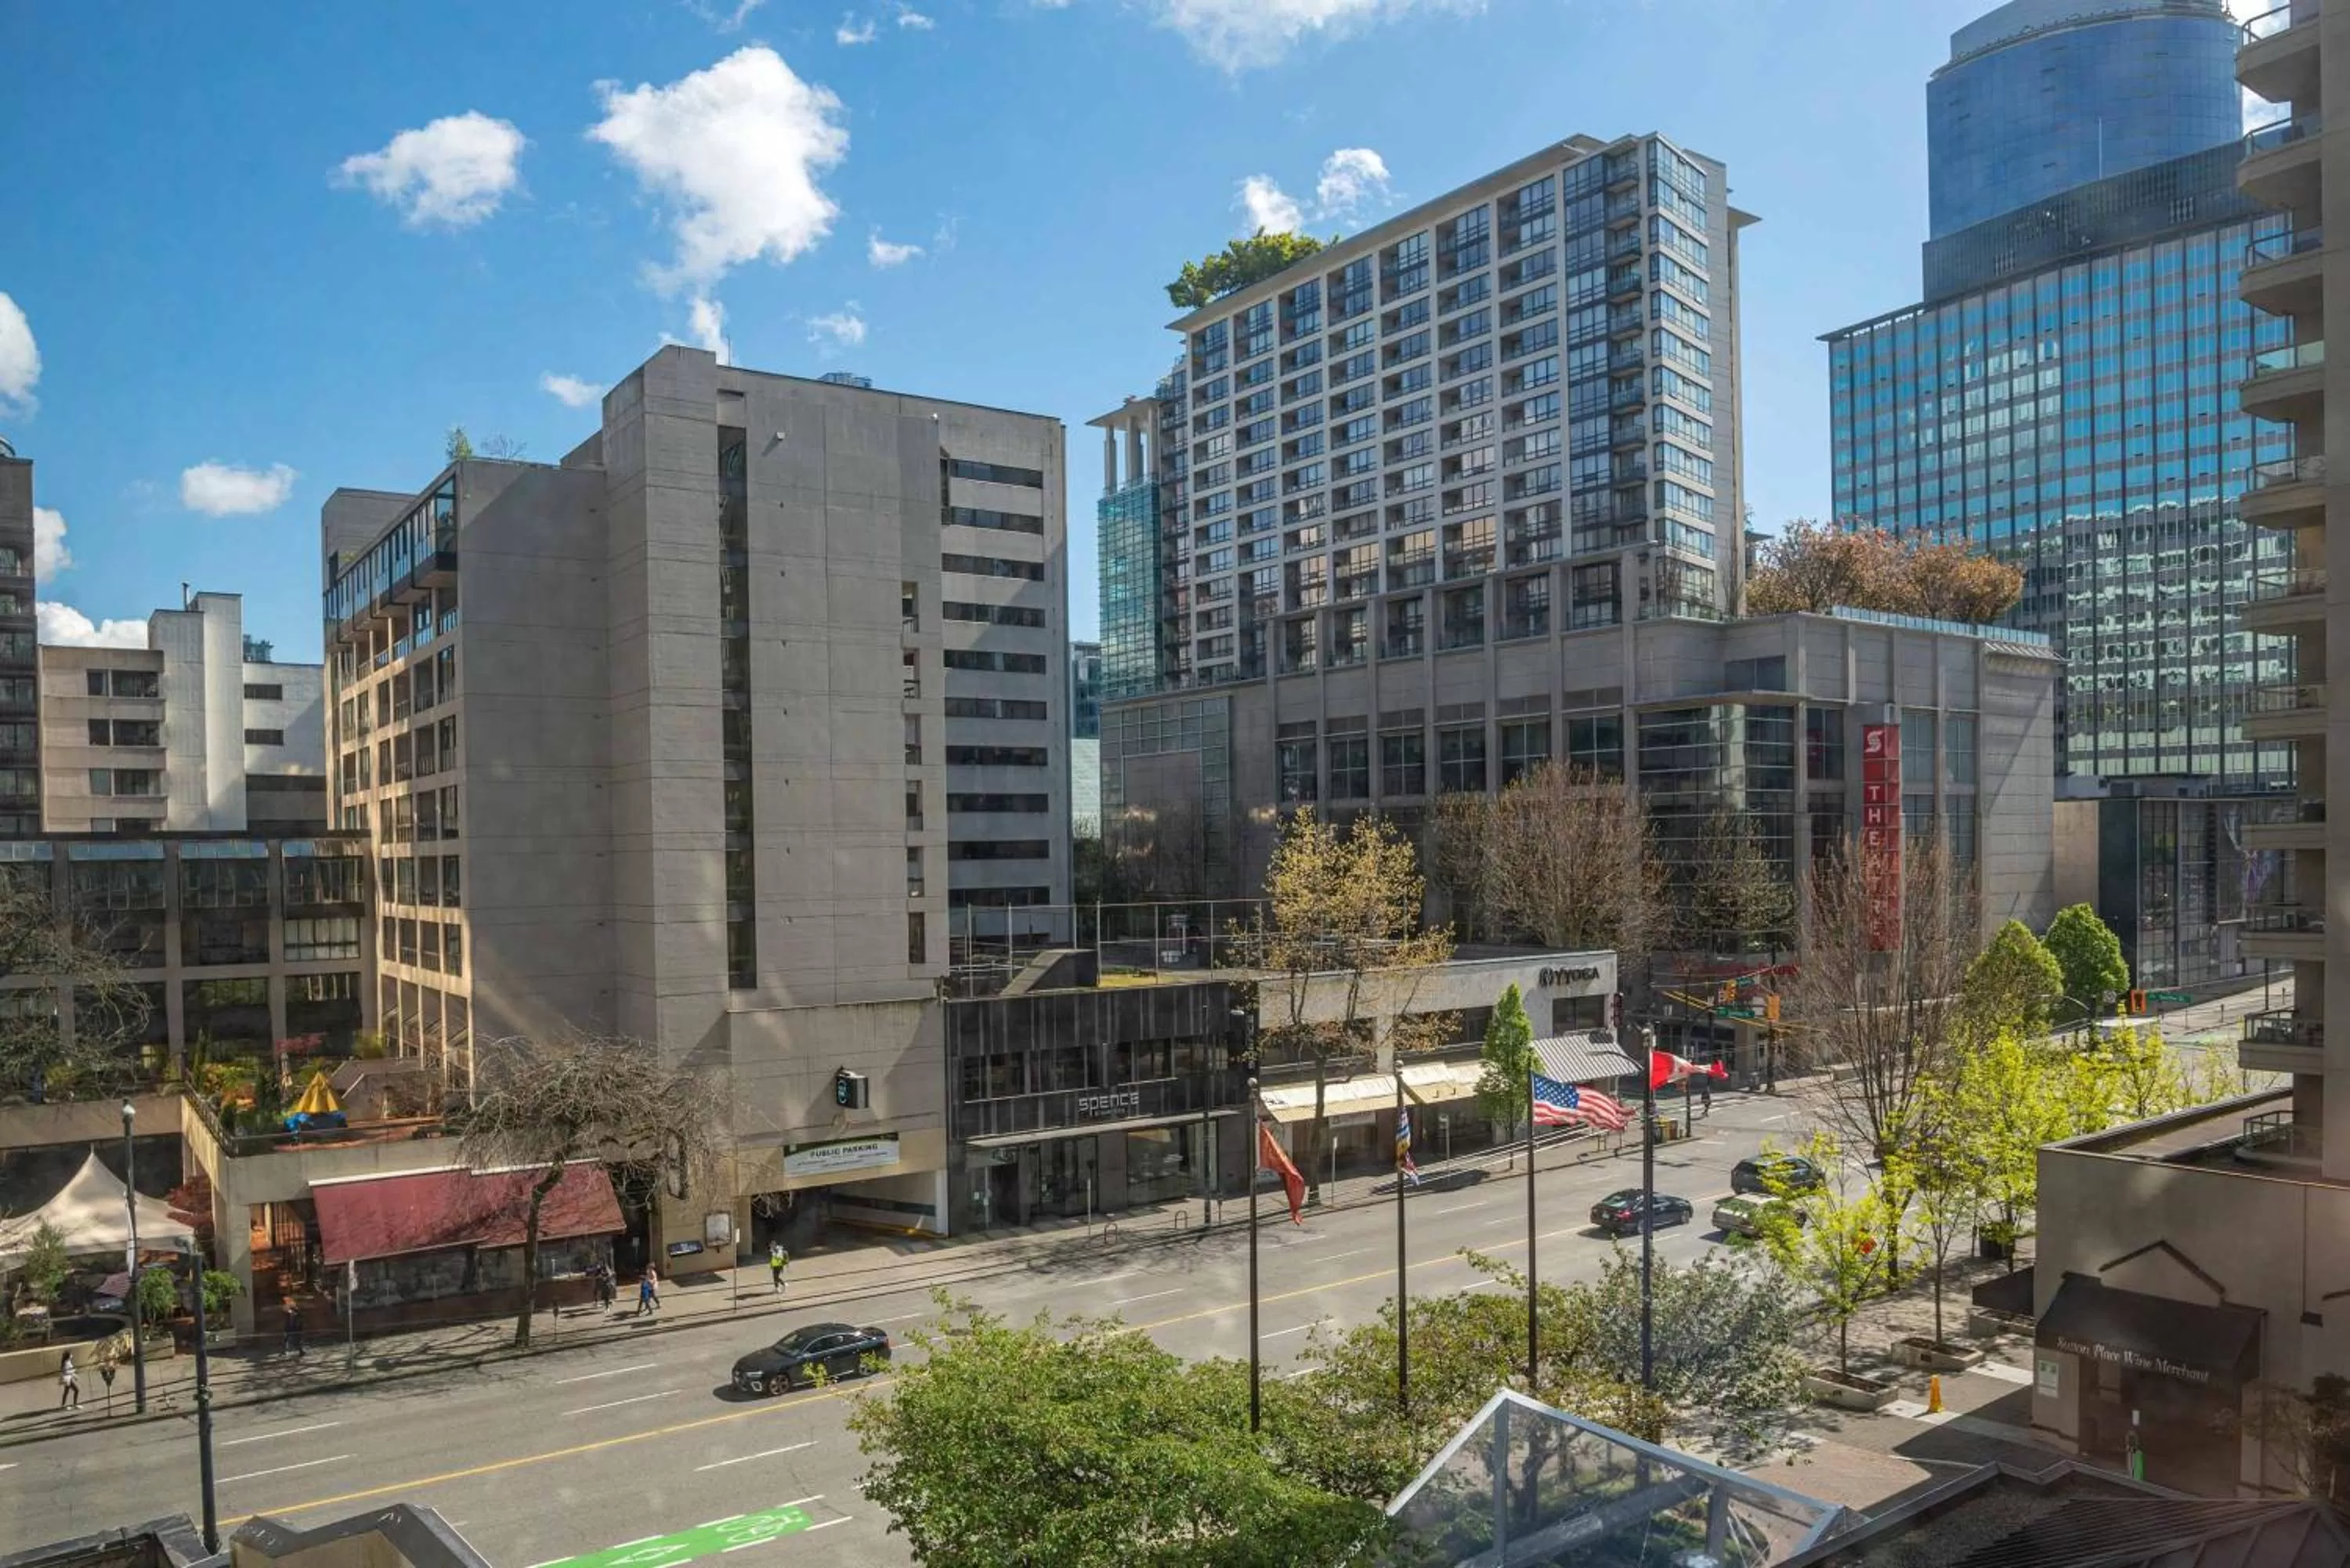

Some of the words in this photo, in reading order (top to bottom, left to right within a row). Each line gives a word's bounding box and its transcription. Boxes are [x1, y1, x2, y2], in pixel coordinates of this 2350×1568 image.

[1867, 786, 1882, 936] THEATRE
[810, 1148, 841, 1158] PUBLIC
[843, 1143, 878, 1154] PARKING
